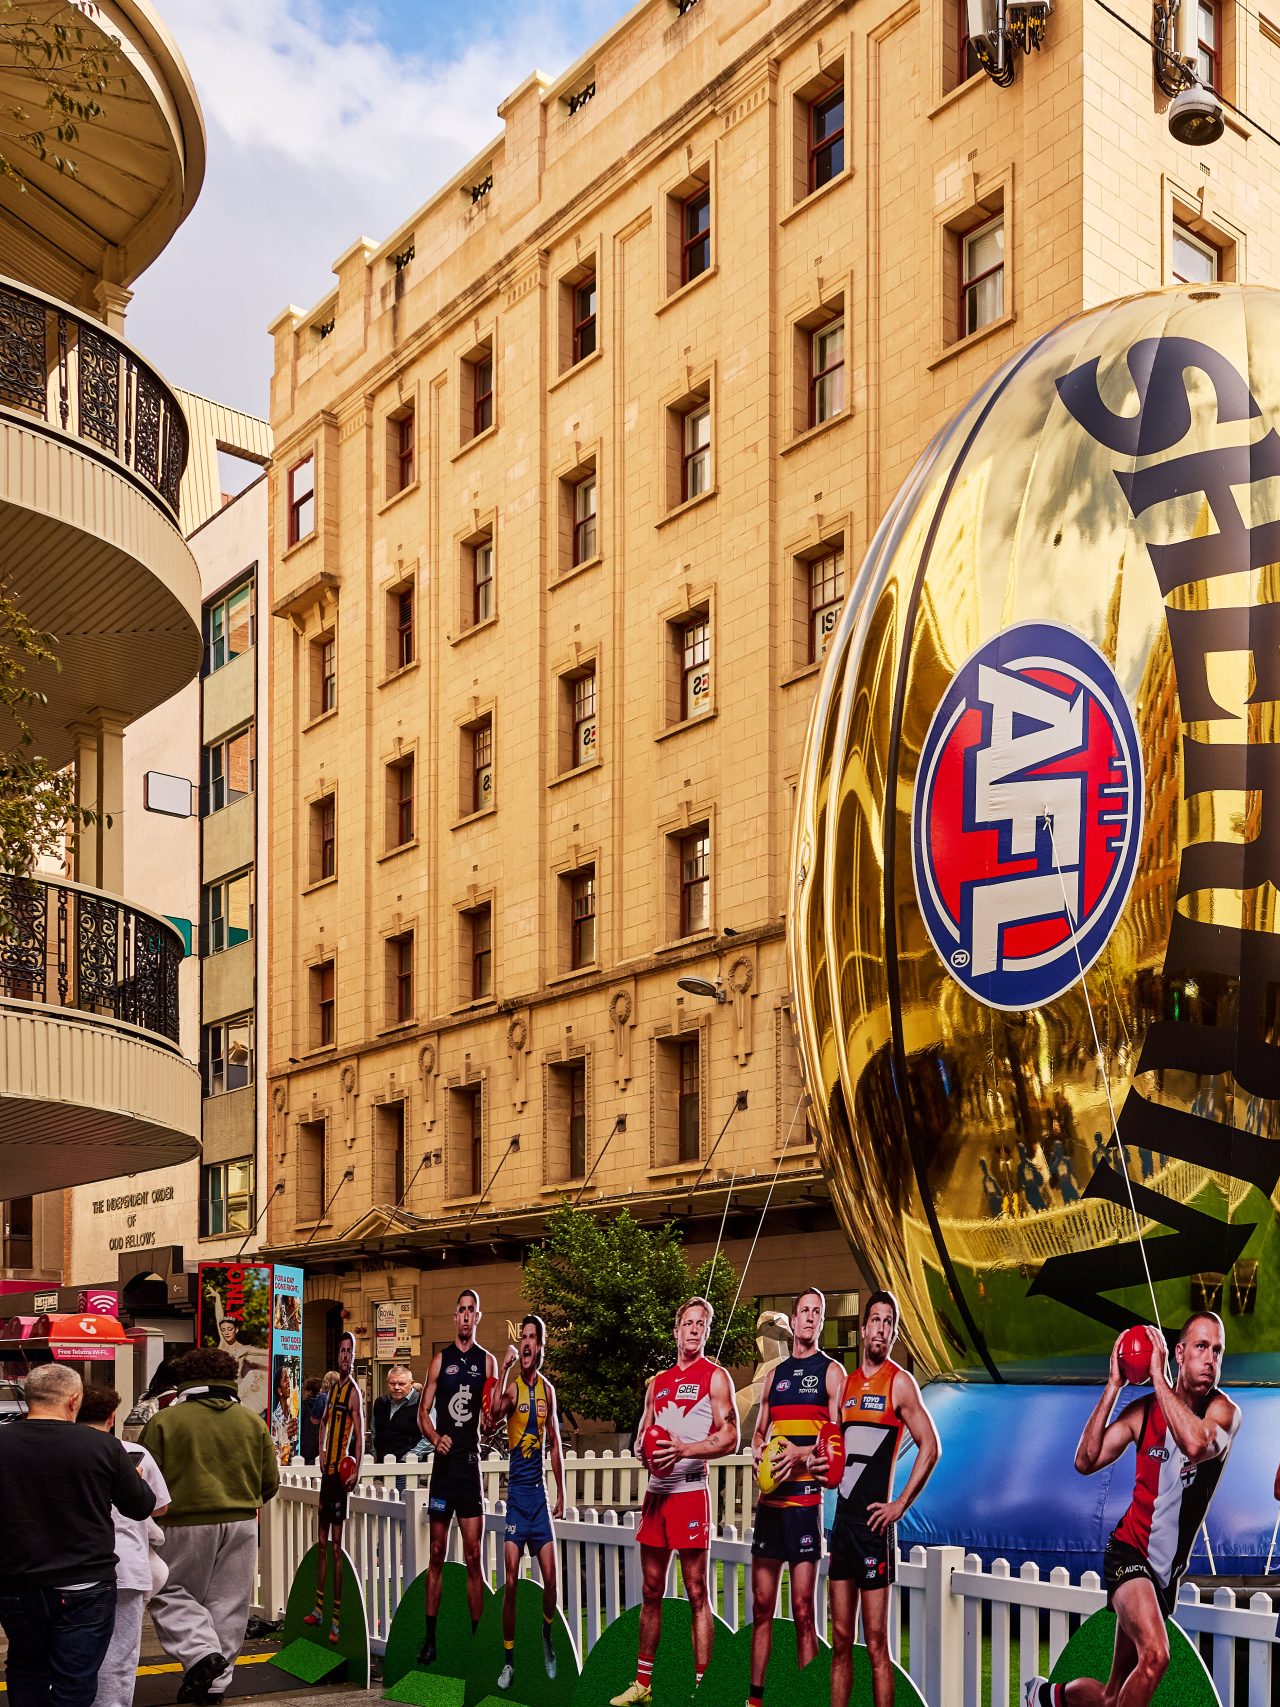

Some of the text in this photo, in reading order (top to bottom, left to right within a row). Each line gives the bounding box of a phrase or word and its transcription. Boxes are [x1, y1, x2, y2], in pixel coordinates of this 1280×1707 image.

[971, 663, 1084, 977] AFL
[92, 1186, 174, 1214] THE INDEPENDENT ORDER
[127, 1214, 137, 1228] OF
[109, 1232, 156, 1251] ODD FELLOWS
[226, 1265, 245, 1321] ONLY
[679, 1384, 698, 1394] QBE
[777, 1381, 789, 1390] AFL
[845, 1398, 855, 1407] AFL
[864, 1402, 884, 1410] TIRES
[1150, 1448, 1169, 1461] AFL
